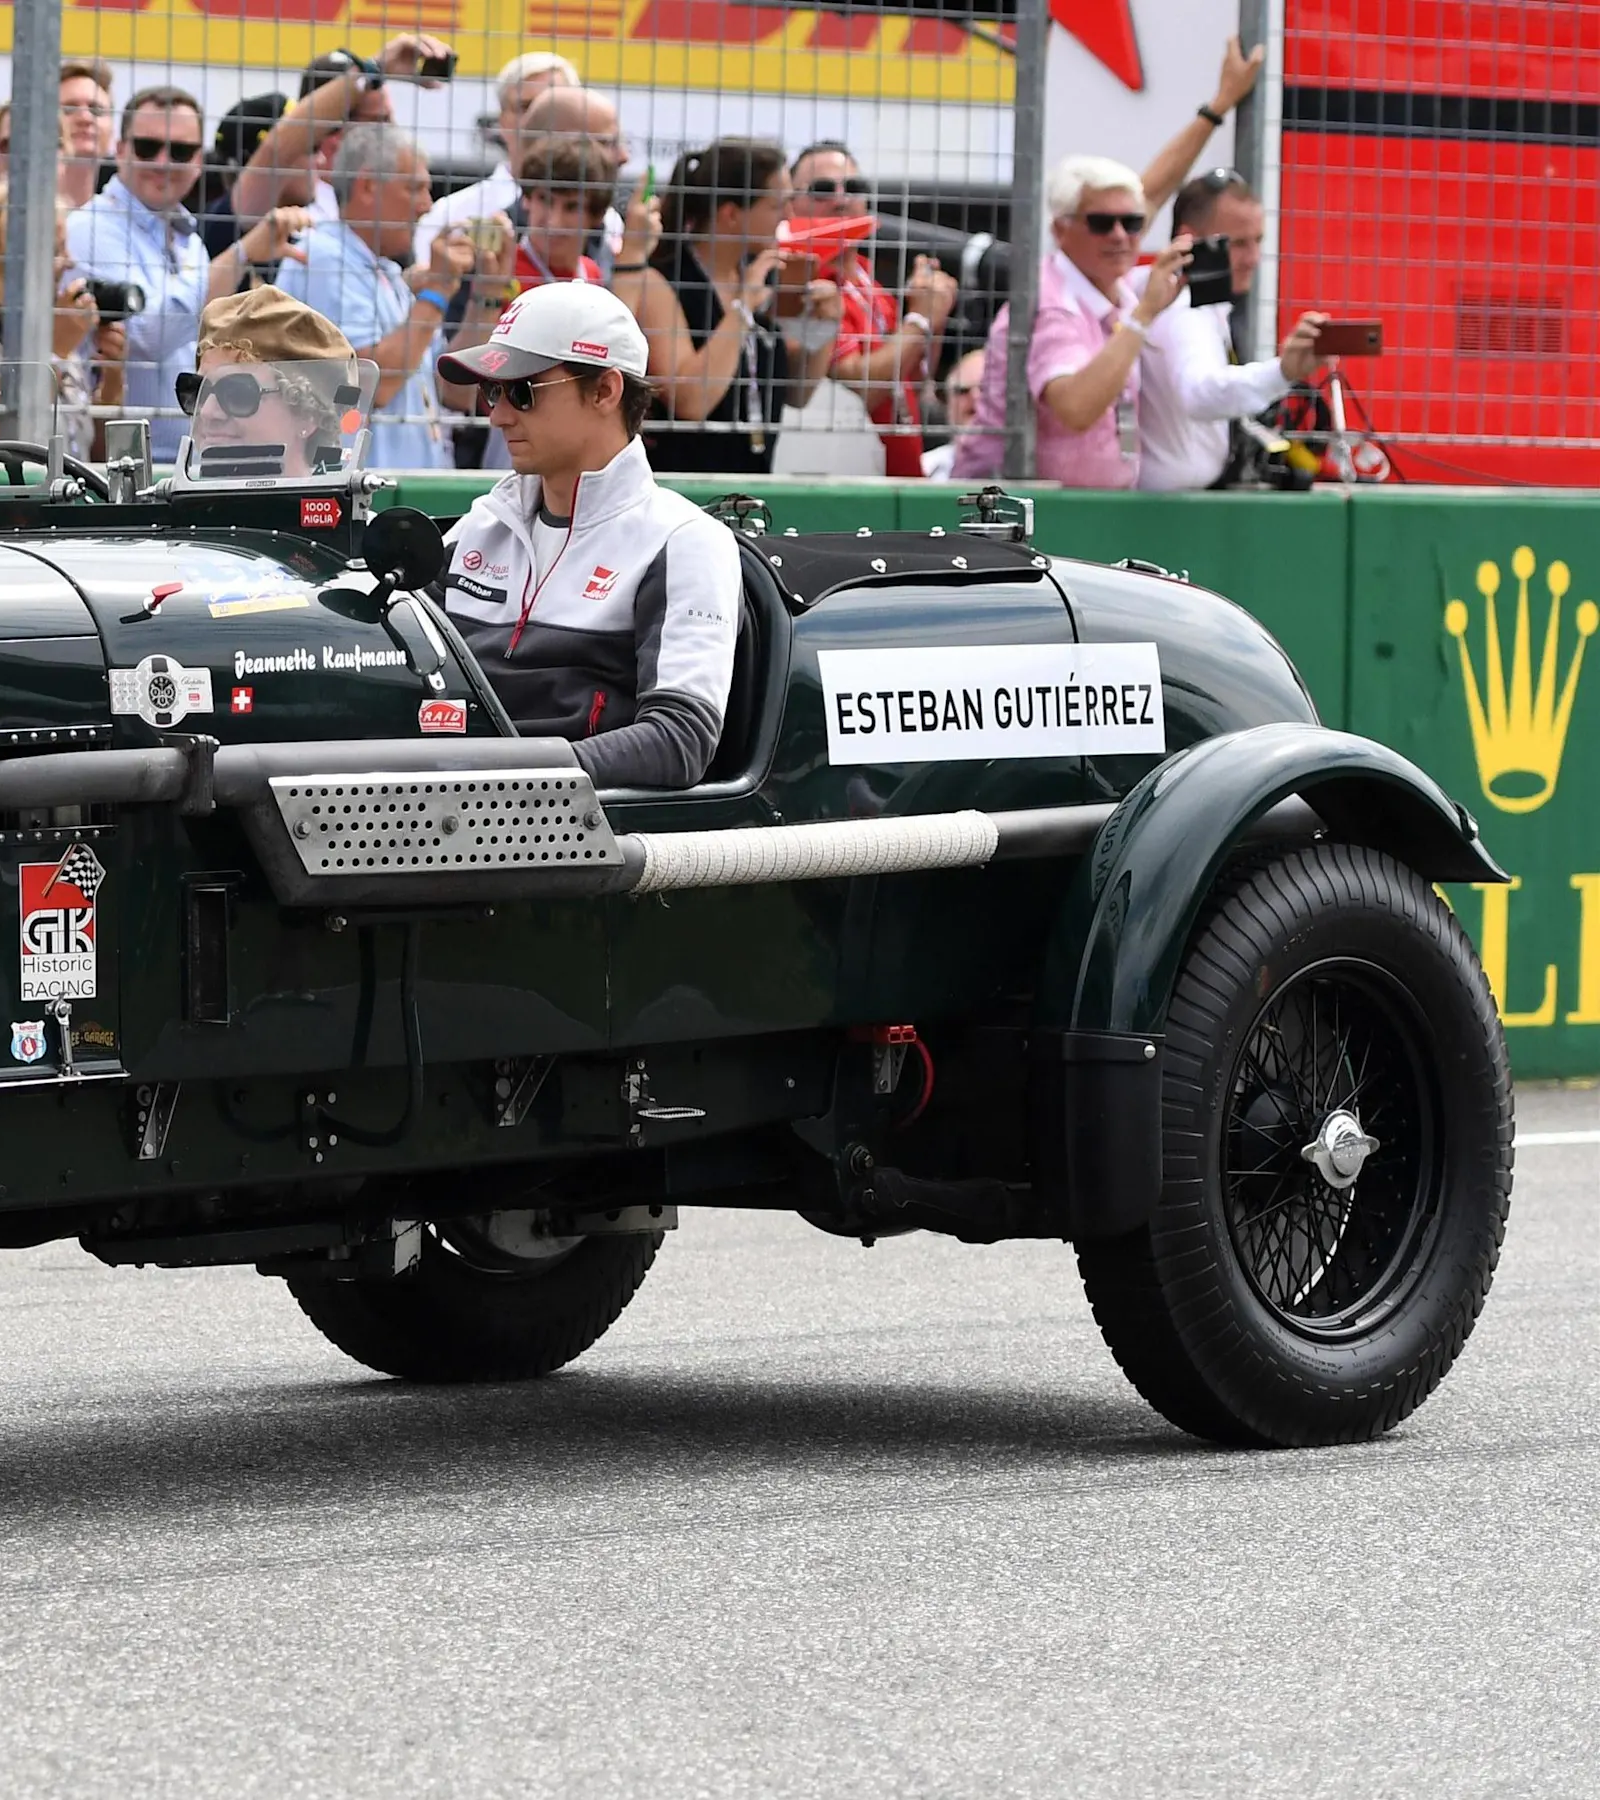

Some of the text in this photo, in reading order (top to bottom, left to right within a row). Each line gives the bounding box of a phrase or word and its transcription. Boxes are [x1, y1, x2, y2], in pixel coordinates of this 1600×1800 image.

[306, 502, 331, 512] 1000
[303, 513, 333, 523] MIGLIA
[457, 577, 492, 597] Esteban
[235, 644, 407, 680] Jeannette Kaufmann
[836, 672, 1155, 735] ESTEBAN GUTIÉRREZ
[422, 711, 462, 721] RAID
[22, 956, 93, 973] Historic
[22, 979, 94, 999] RACING
